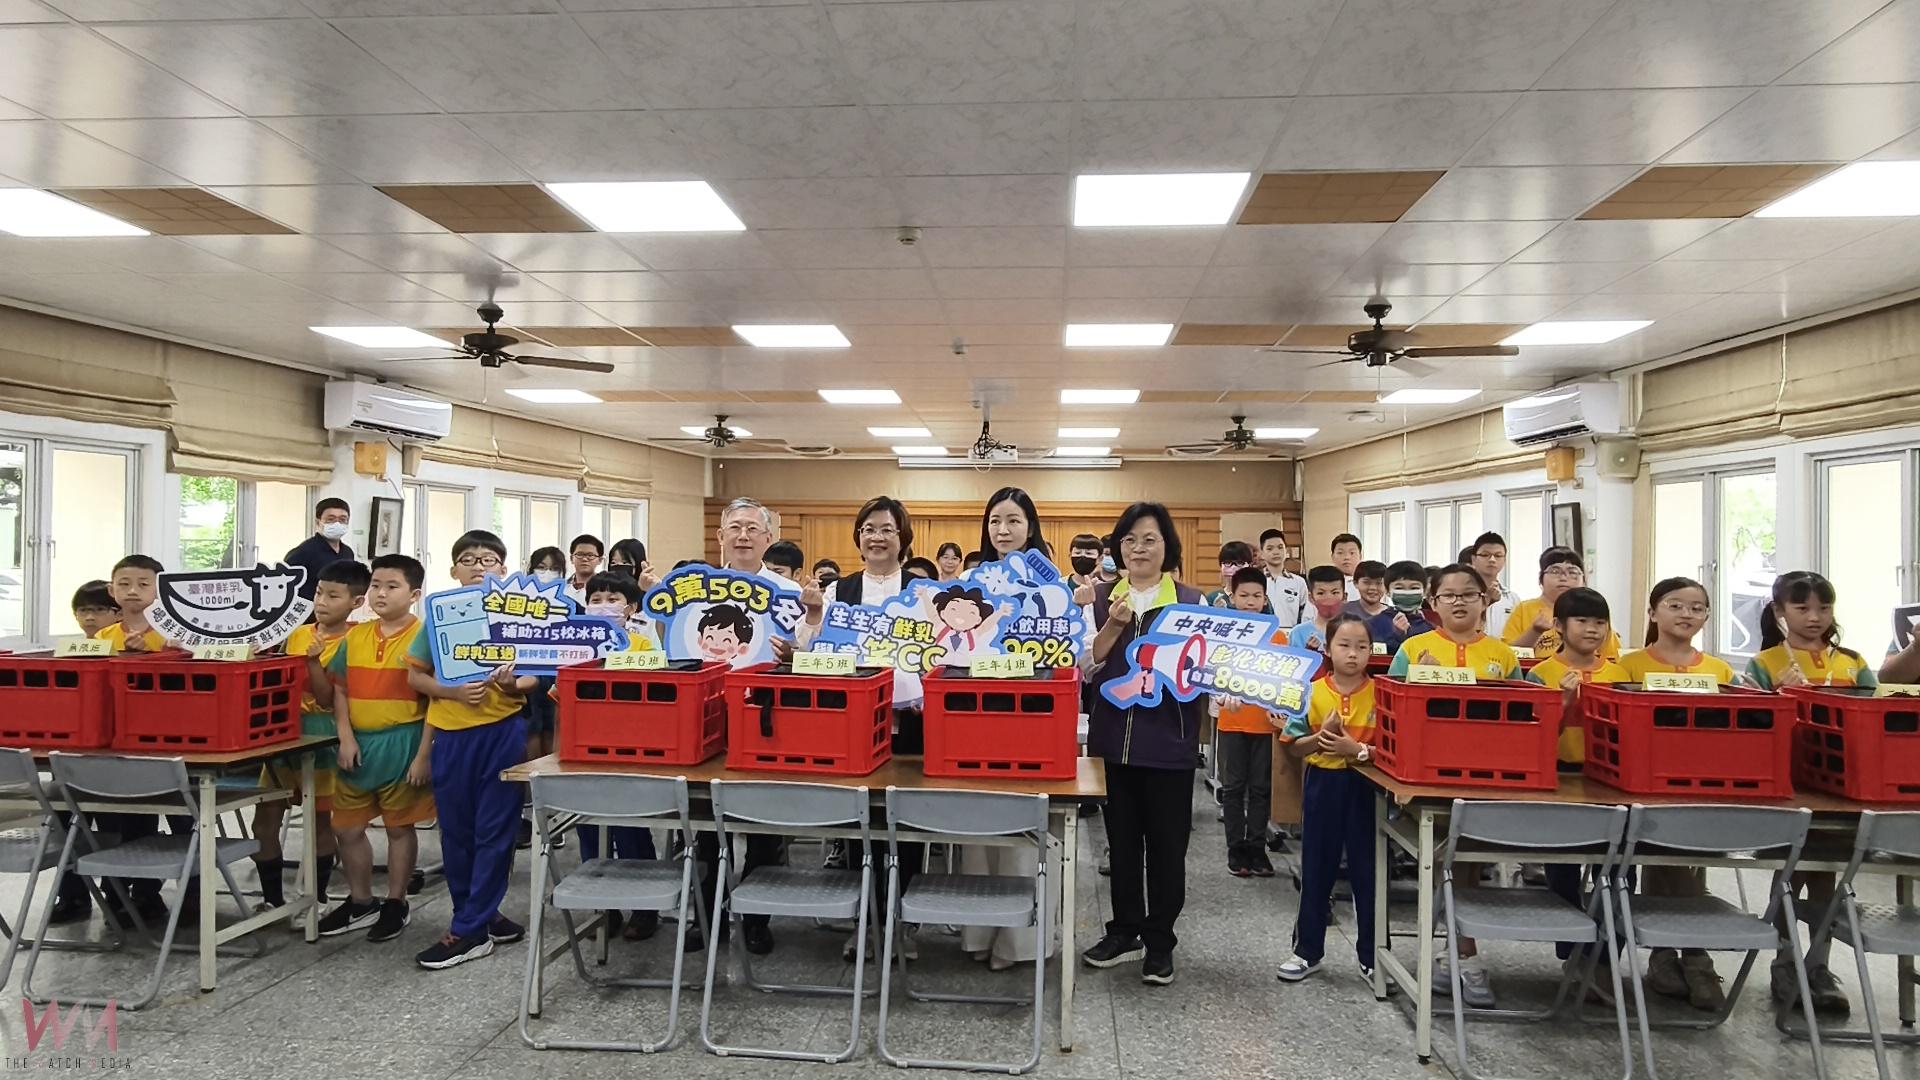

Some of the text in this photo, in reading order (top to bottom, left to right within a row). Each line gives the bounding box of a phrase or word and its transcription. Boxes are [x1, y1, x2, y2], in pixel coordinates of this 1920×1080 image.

[187, 581, 243, 594] 臺灣鮮乳
[200, 595, 235, 604] 1000ml
[484, 591, 569, 618] 全國唯一
[649, 573, 803, 631] 9萬503名
[501, 624, 606, 641] 補助215校冰箱
[829, 607, 935, 644] 生生有鮮乳
[1174, 615, 1256, 640] 中央喊卡
[454, 644, 517, 661] 鮮乳直送
[611, 652, 660, 666] 三年6班
[799, 657, 849, 670] 三年5班
[976, 658, 1027, 672] 三年4班
[1417, 670, 1470, 683] 三年3班
[1653, 678, 1710, 689] 三年2班
